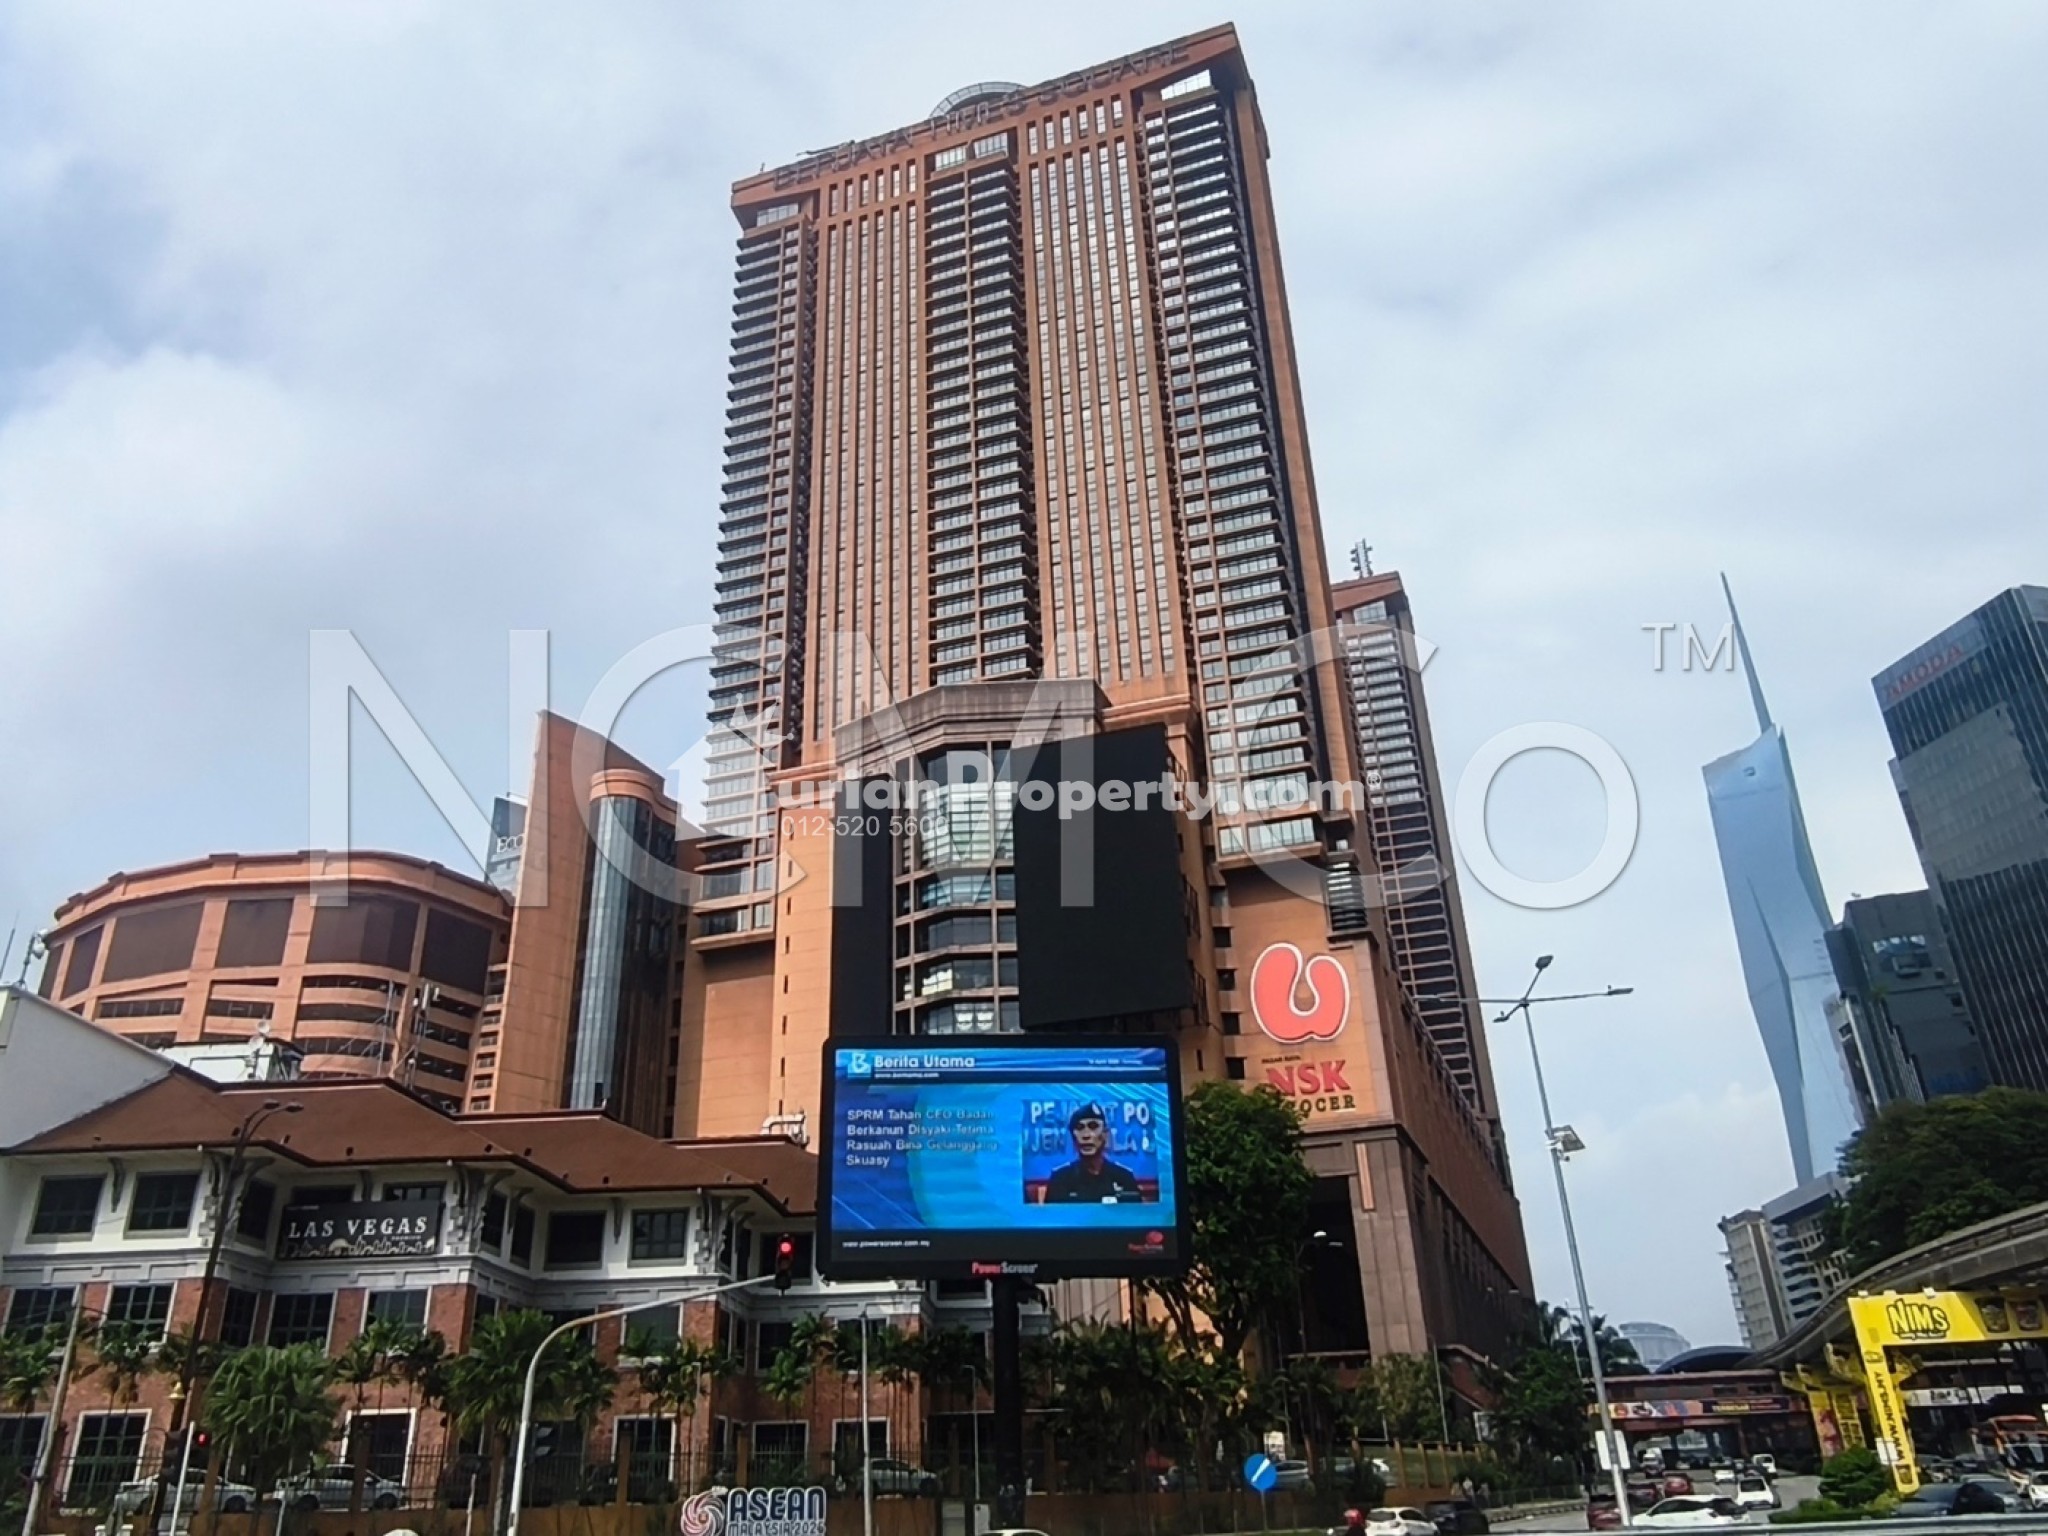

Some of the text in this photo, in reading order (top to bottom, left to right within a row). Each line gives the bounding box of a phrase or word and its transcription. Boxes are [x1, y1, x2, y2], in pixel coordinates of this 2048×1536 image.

[874, 1054, 919, 1068] Berita
[923, 1053, 975, 1068] Utama
[1265, 1059, 1351, 1097] NSK
[847, 1109, 884, 1121] SPRM
[887, 1109, 922, 1120] Tahan
[847, 1124, 904, 1135] Berkanun
[846, 1139, 892, 1151] Rasuah
[846, 1155, 890, 1168] Skuasy
[287, 1216, 428, 1239] LAS VEGAS
[728, 1486, 826, 1521] ASEAN
